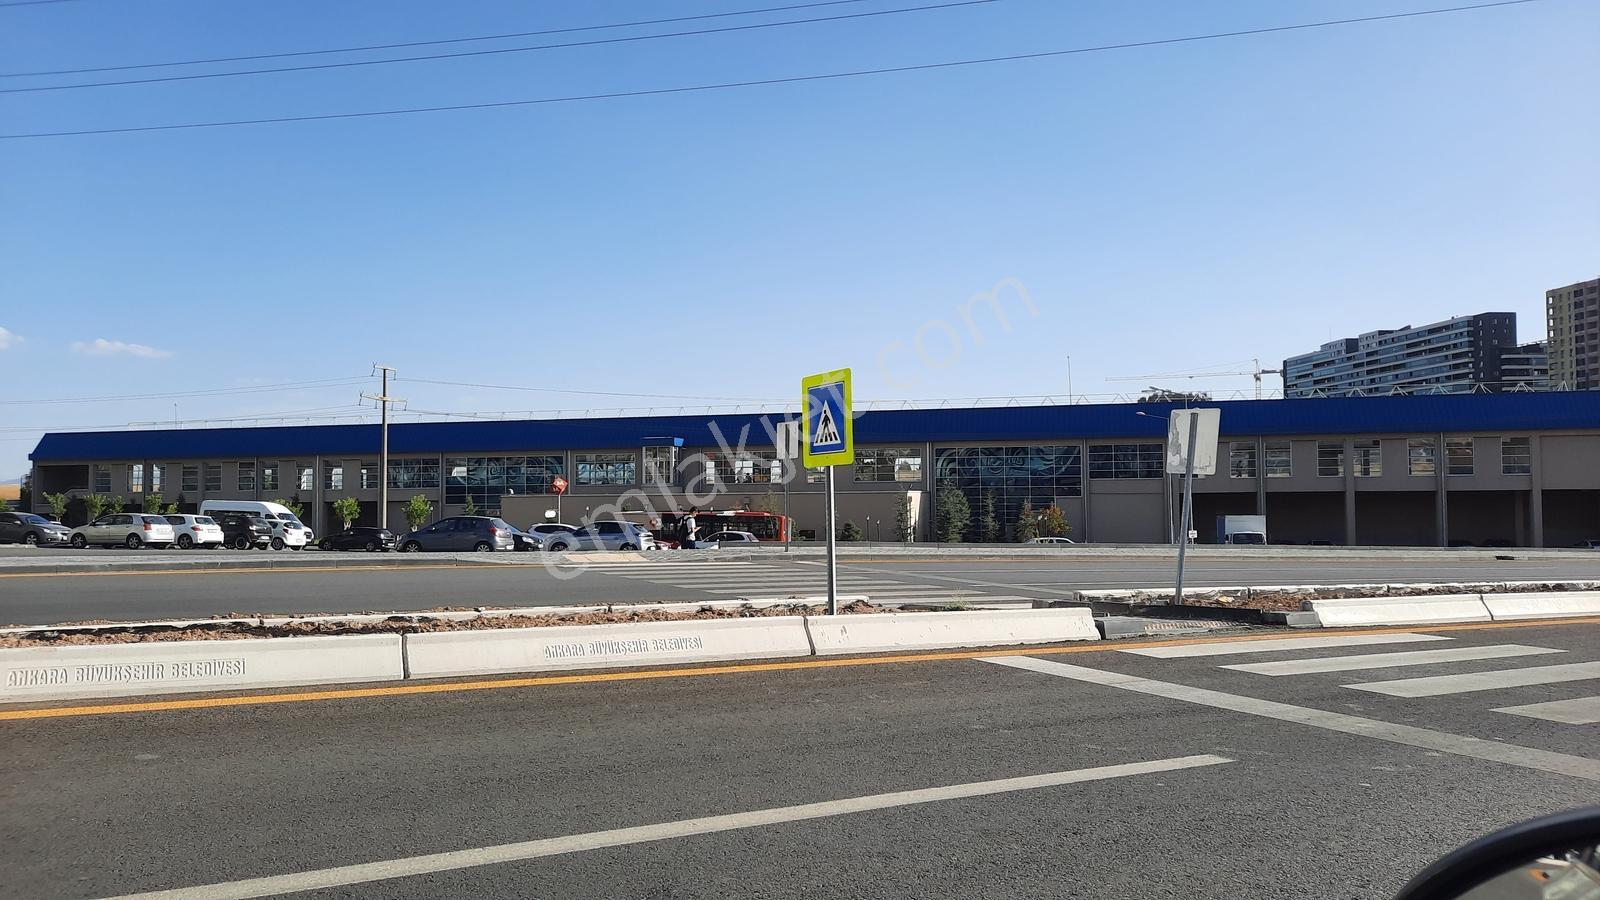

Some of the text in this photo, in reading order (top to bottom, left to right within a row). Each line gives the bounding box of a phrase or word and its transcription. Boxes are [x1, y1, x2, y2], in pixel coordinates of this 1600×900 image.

[544, 643, 585, 659] ANKARA
[7, 657, 247, 687] ANKARA BÜYÜKŞEHİR BELEDİYESİ
